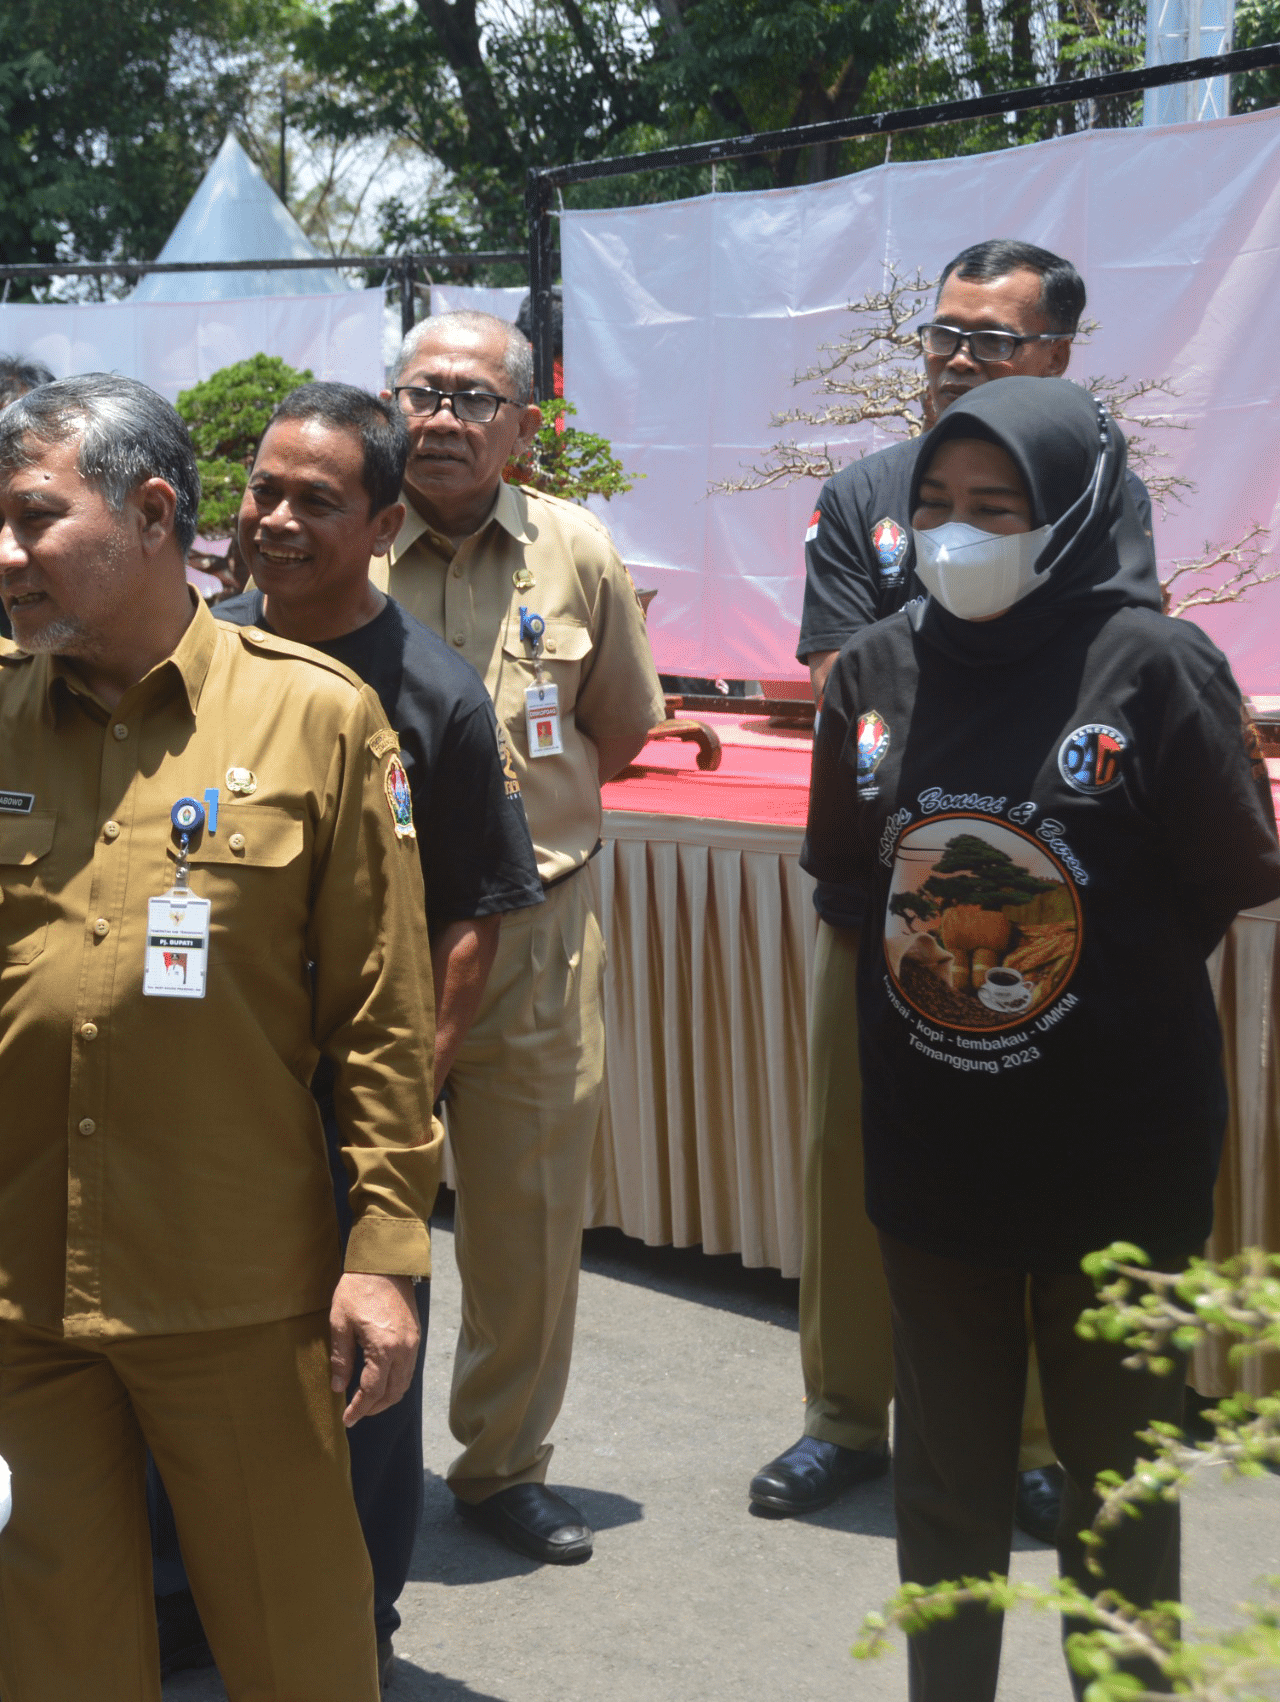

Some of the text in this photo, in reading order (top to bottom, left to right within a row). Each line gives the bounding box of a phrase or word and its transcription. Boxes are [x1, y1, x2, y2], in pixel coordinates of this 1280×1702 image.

[918, 787, 1007, 814] Bonsai
[1008, 801, 1038, 824] &
[1036, 818, 1090, 886] Bursa
[169, 939, 194, 947] BUPATI
[916, 1019, 944, 1043] kopi
[956, 1032, 1028, 1051] tembakau
[1035, 992, 1079, 1032] UMKM
[908, 1033, 1041, 1074] Temanggung 2023
